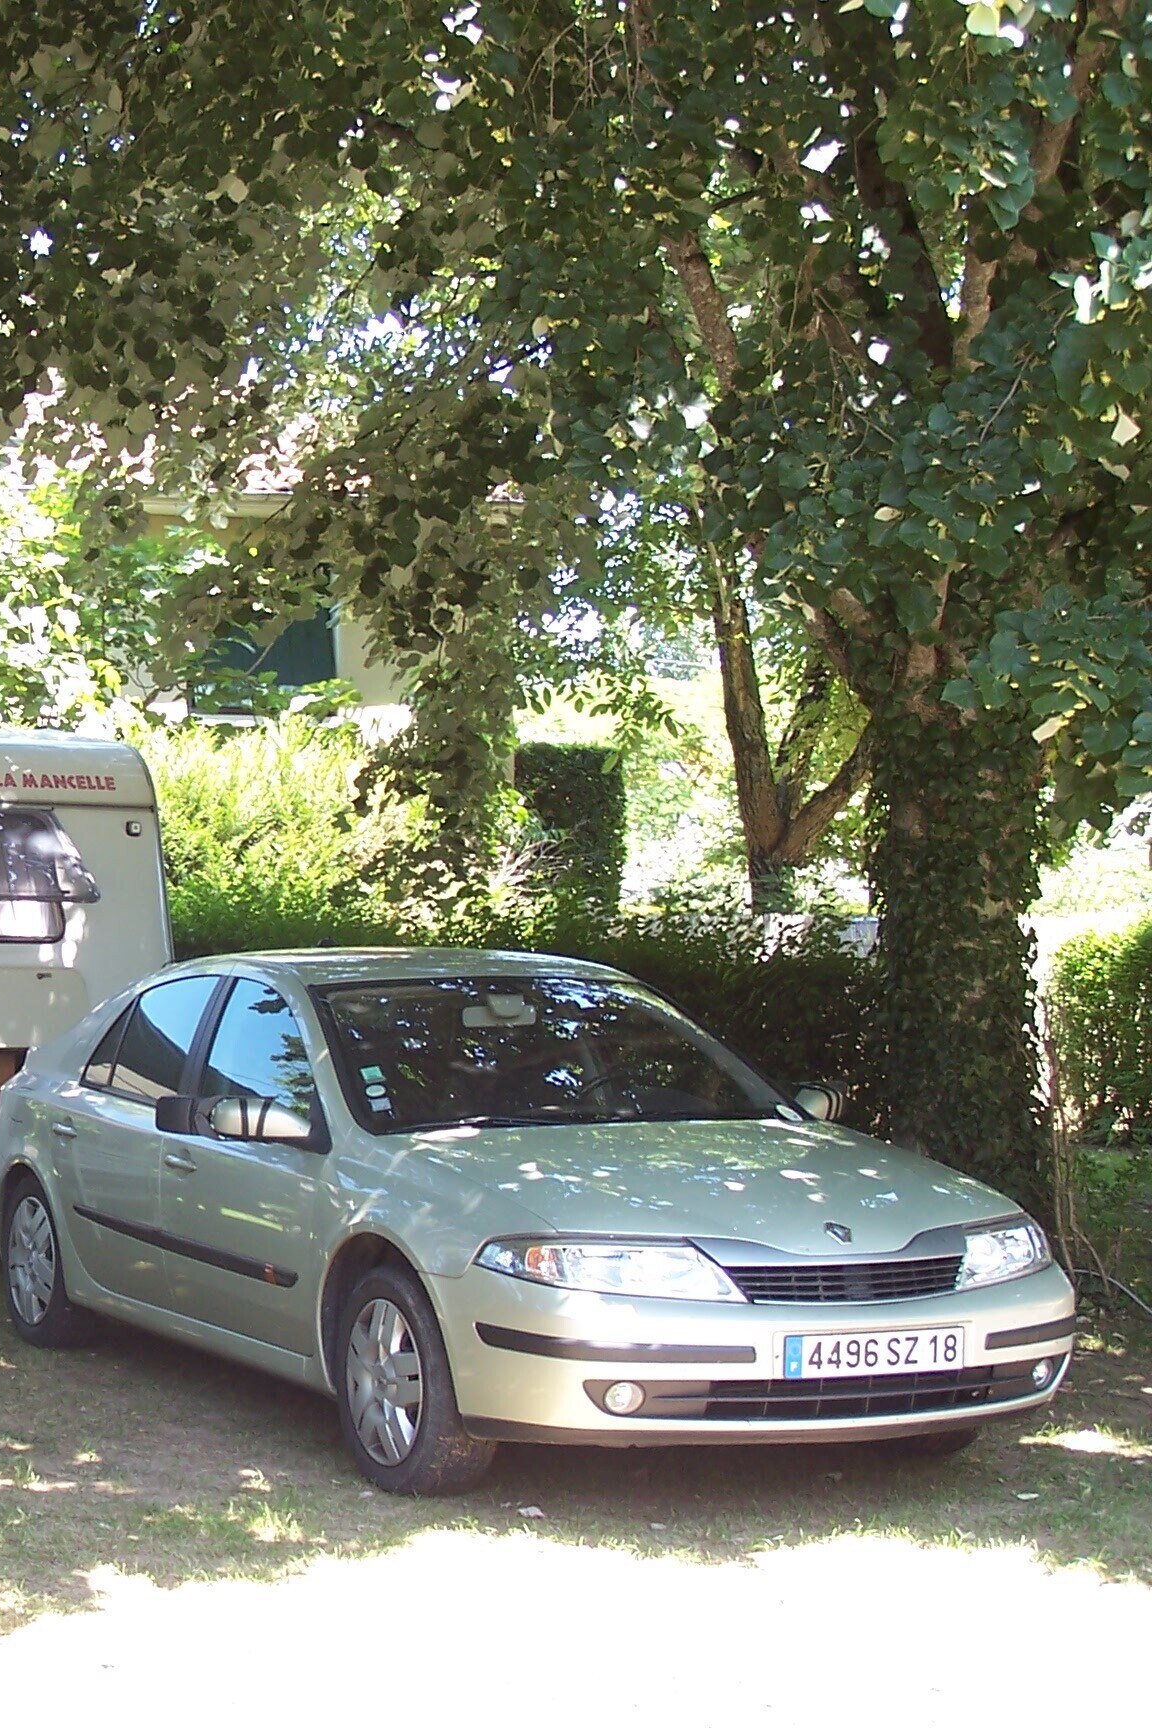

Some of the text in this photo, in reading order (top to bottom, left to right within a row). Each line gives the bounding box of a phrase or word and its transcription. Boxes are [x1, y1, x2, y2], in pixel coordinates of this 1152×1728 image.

[22, 773, 116, 791] MANCELLE
[808, 1334, 957, 1370] 4496 SZ 18
